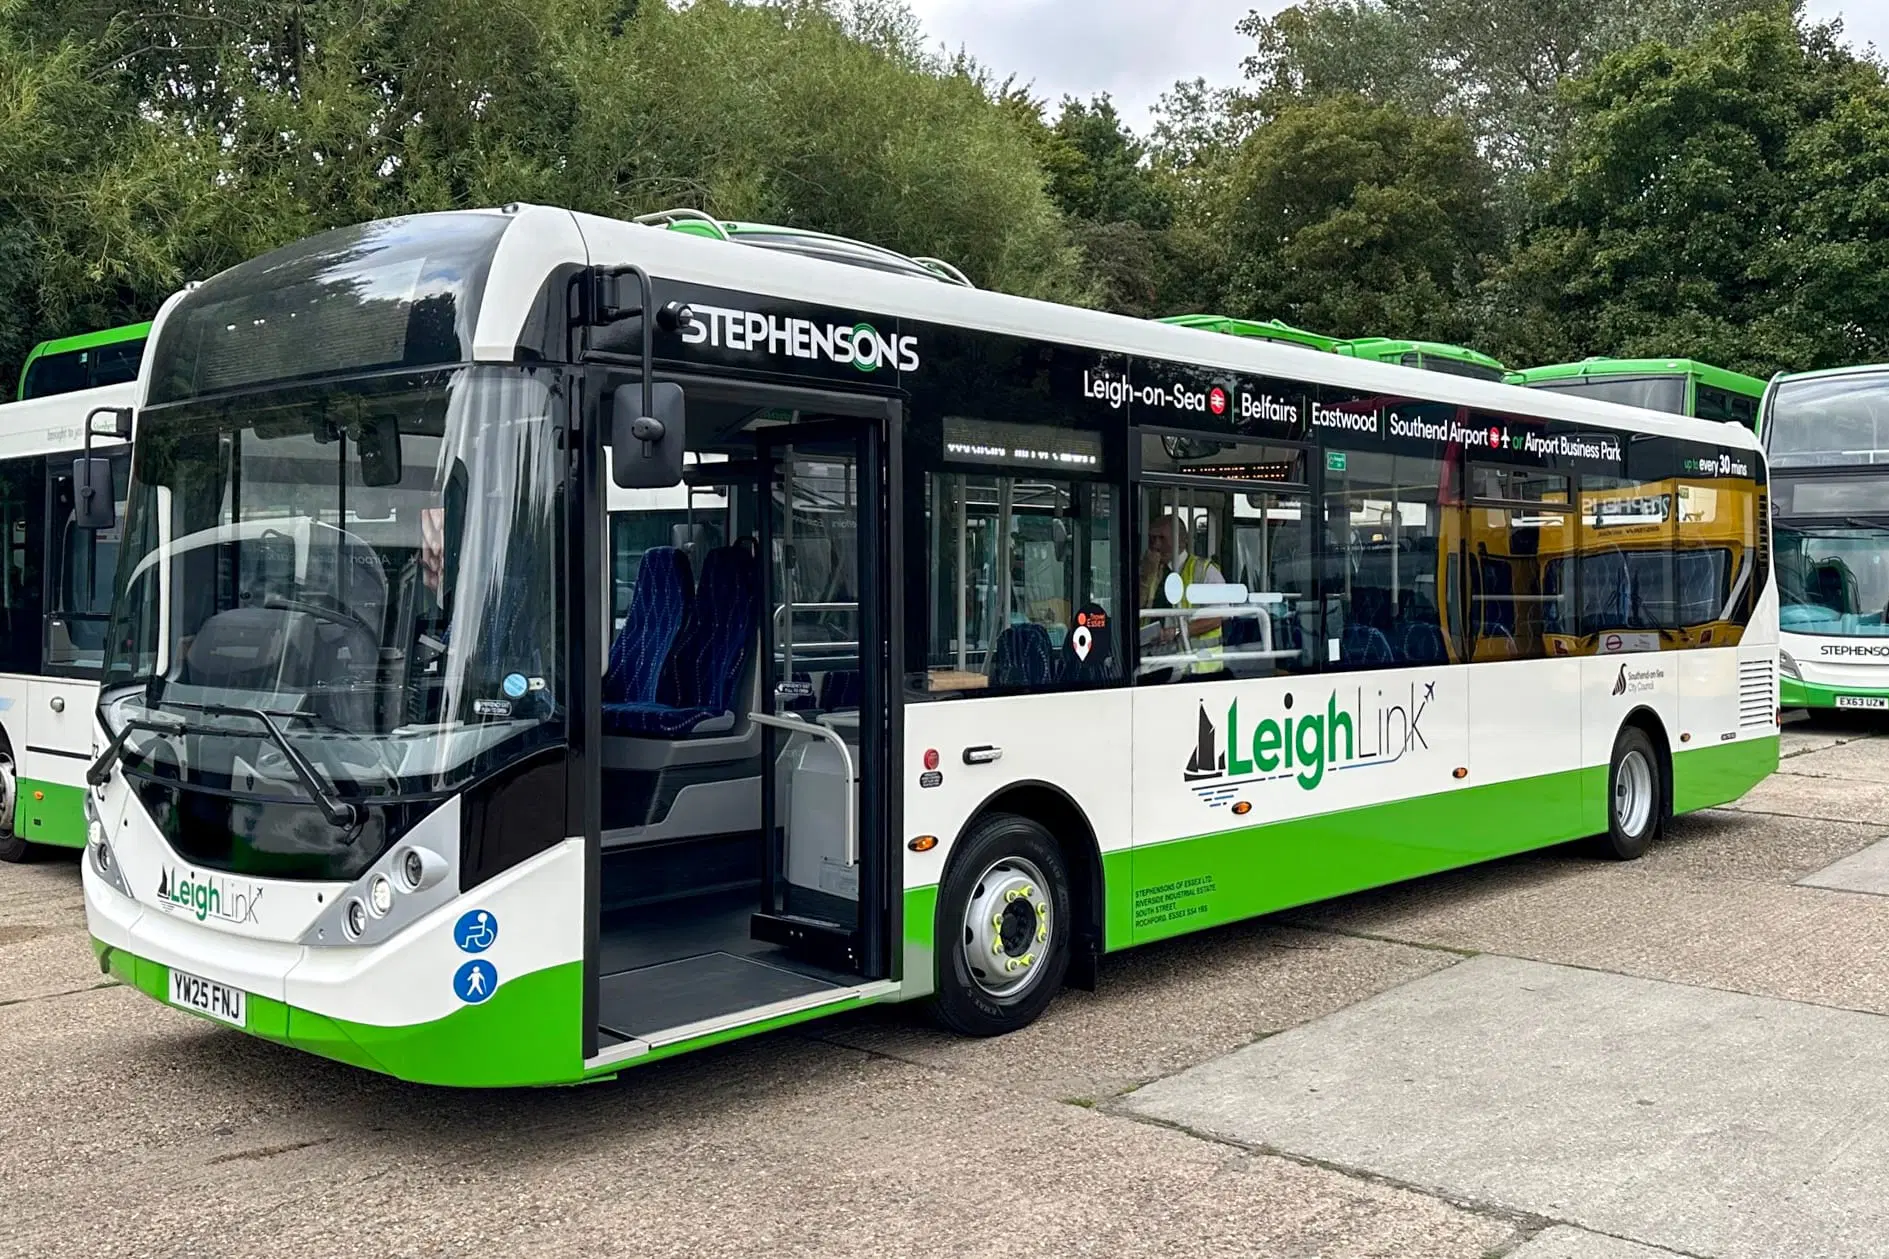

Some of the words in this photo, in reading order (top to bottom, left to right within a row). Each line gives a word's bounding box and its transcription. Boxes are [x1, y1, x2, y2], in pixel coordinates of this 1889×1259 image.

[682, 303, 920, 372] STEPHENSONS
[1084, 370, 1206, 412] Leigh-on-Sea
[1241, 392, 1298, 423] Belfairs
[1312, 402, 1378, 433] Eastwood
[1390, 414, 1448, 442] Southend
[1450, 422, 1489, 449] Airport
[1512, 436, 1523, 449] or
[1524, 432, 1560, 458] Airport
[1561, 437, 1600, 460] Business
[1601, 441, 1621, 462] Park
[1699, 458, 1718, 477] every
[1719, 453, 1731, 475] 30
[1731, 458, 1747, 477] mins
[1839, 697, 1864, 706] EX63
[1866, 698, 1885, 707] UZW
[1136, 882, 1175, 898] STEPHENSONS
[1176, 881, 1183, 890] OF
[1184, 877, 1201, 888] ESSEX
[1136, 896, 1164, 909] RIVERSIDE
[1165, 890, 1195, 903] INDUSTRIAL
[1196, 884, 1216, 895] ESTATE
[1136, 907, 1154, 919] SOUTH
[1156, 902, 1177, 914] STREET
[1169, 909, 1186, 920] ESSEX
[174, 972, 209, 1009] YW25
[212, 986, 240, 1019] FNJ
